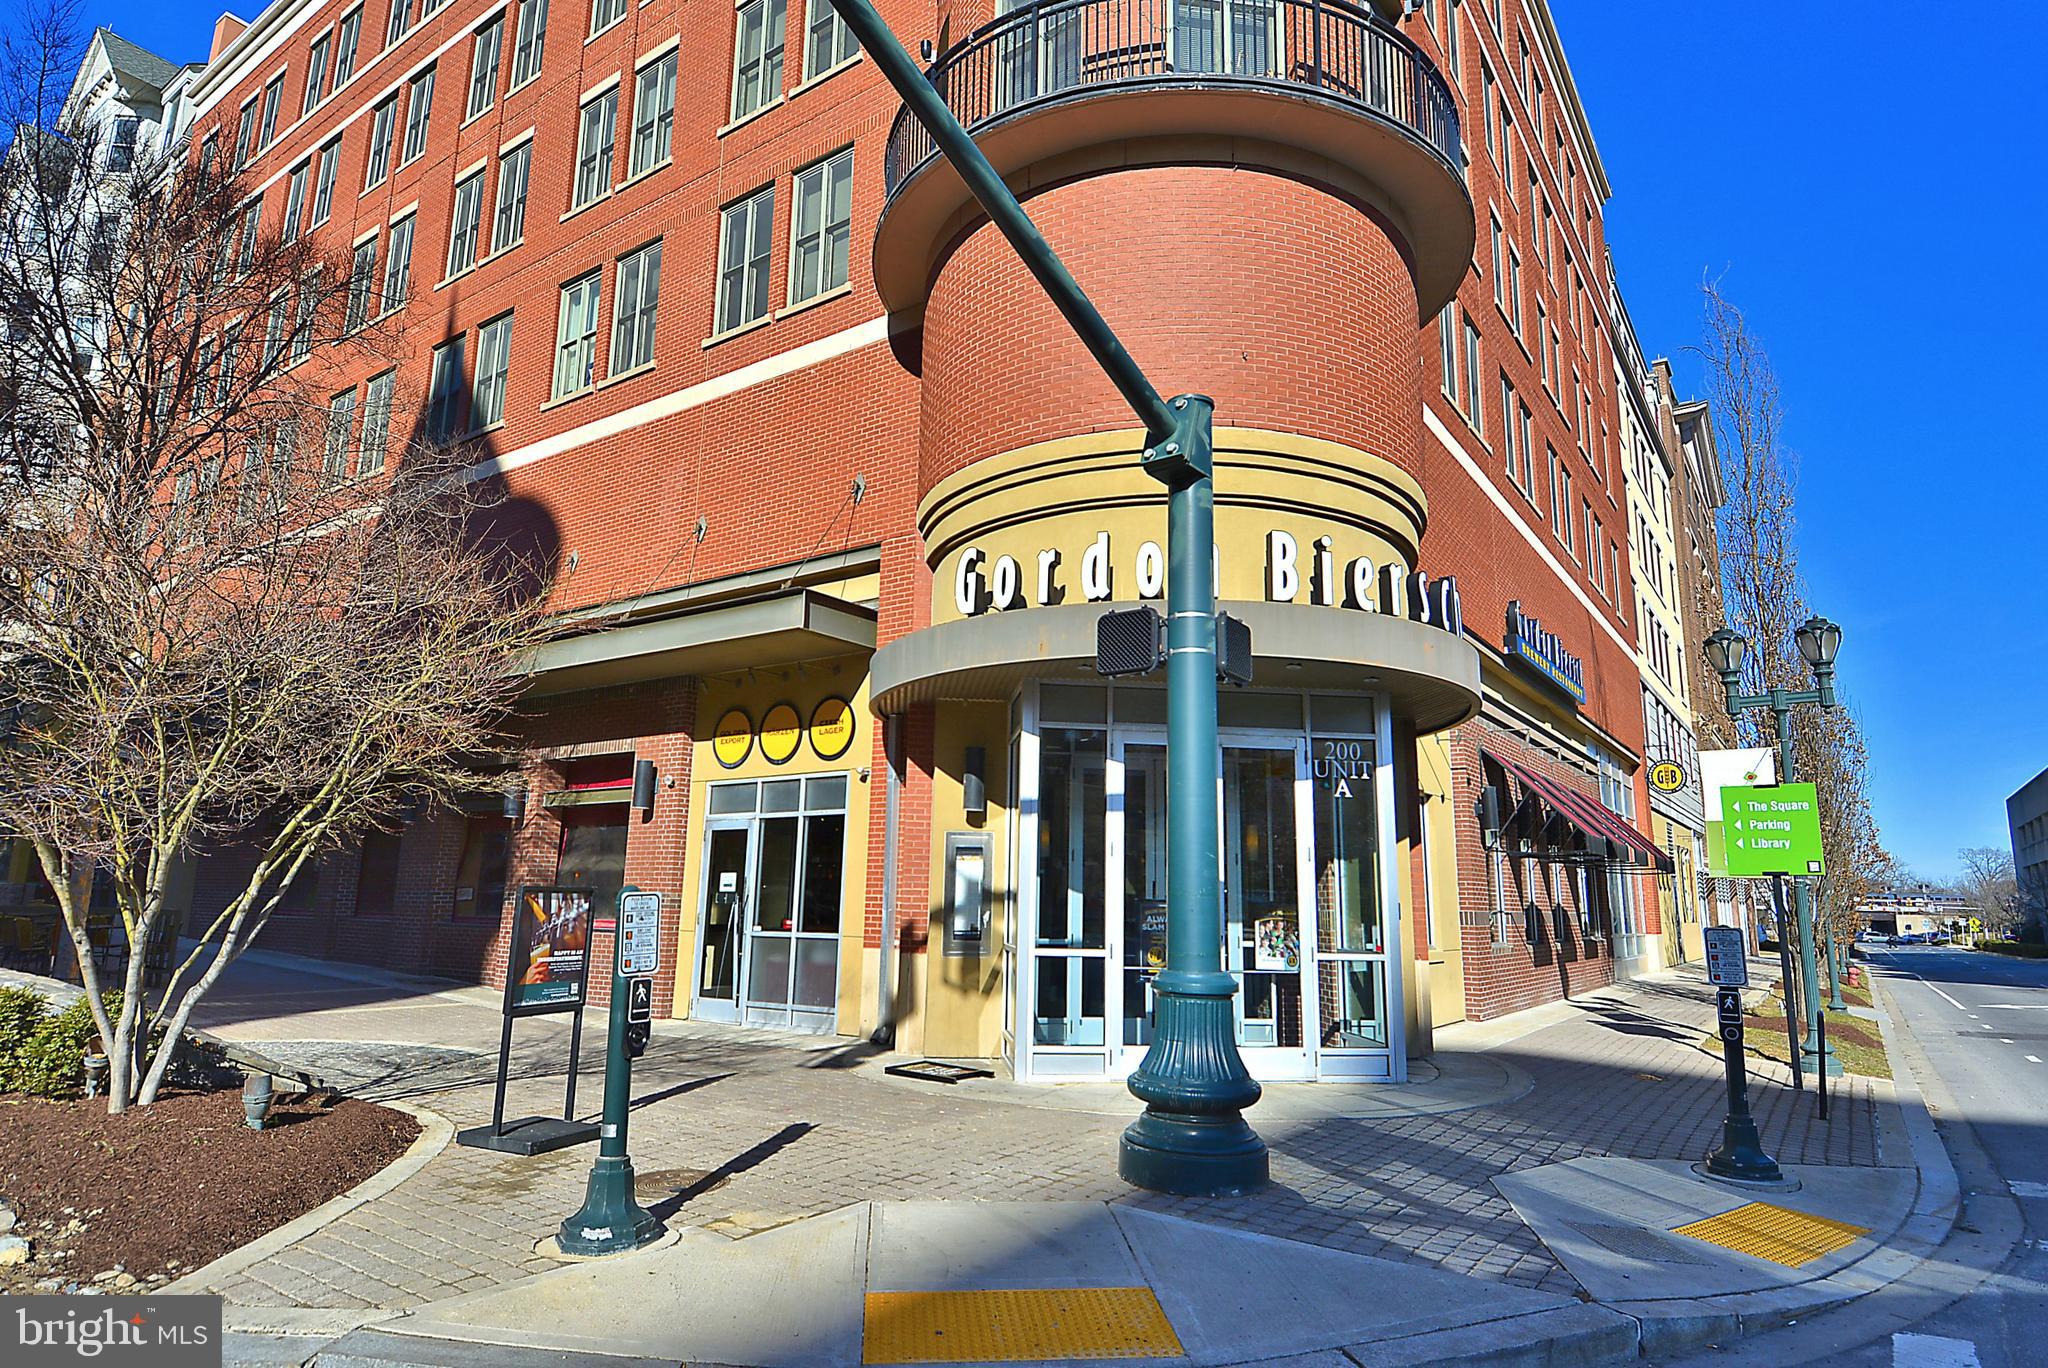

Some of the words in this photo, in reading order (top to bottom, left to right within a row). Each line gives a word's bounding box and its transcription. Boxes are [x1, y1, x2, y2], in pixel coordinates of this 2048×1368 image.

[955, 530, 1219, 615] Gordo
[818, 726, 844, 736] LAGER
[720, 736, 746, 745] EXPORT
[1324, 741, 1361, 760] 200
[1313, 760, 1373, 780] UNIT
[1334, 778, 1353, 798] A
[1747, 801, 1768, 812] The
[1770, 801, 1811, 813] Square
[1749, 819, 1791, 832] Parking
[1751, 838, 1791, 850] Library
